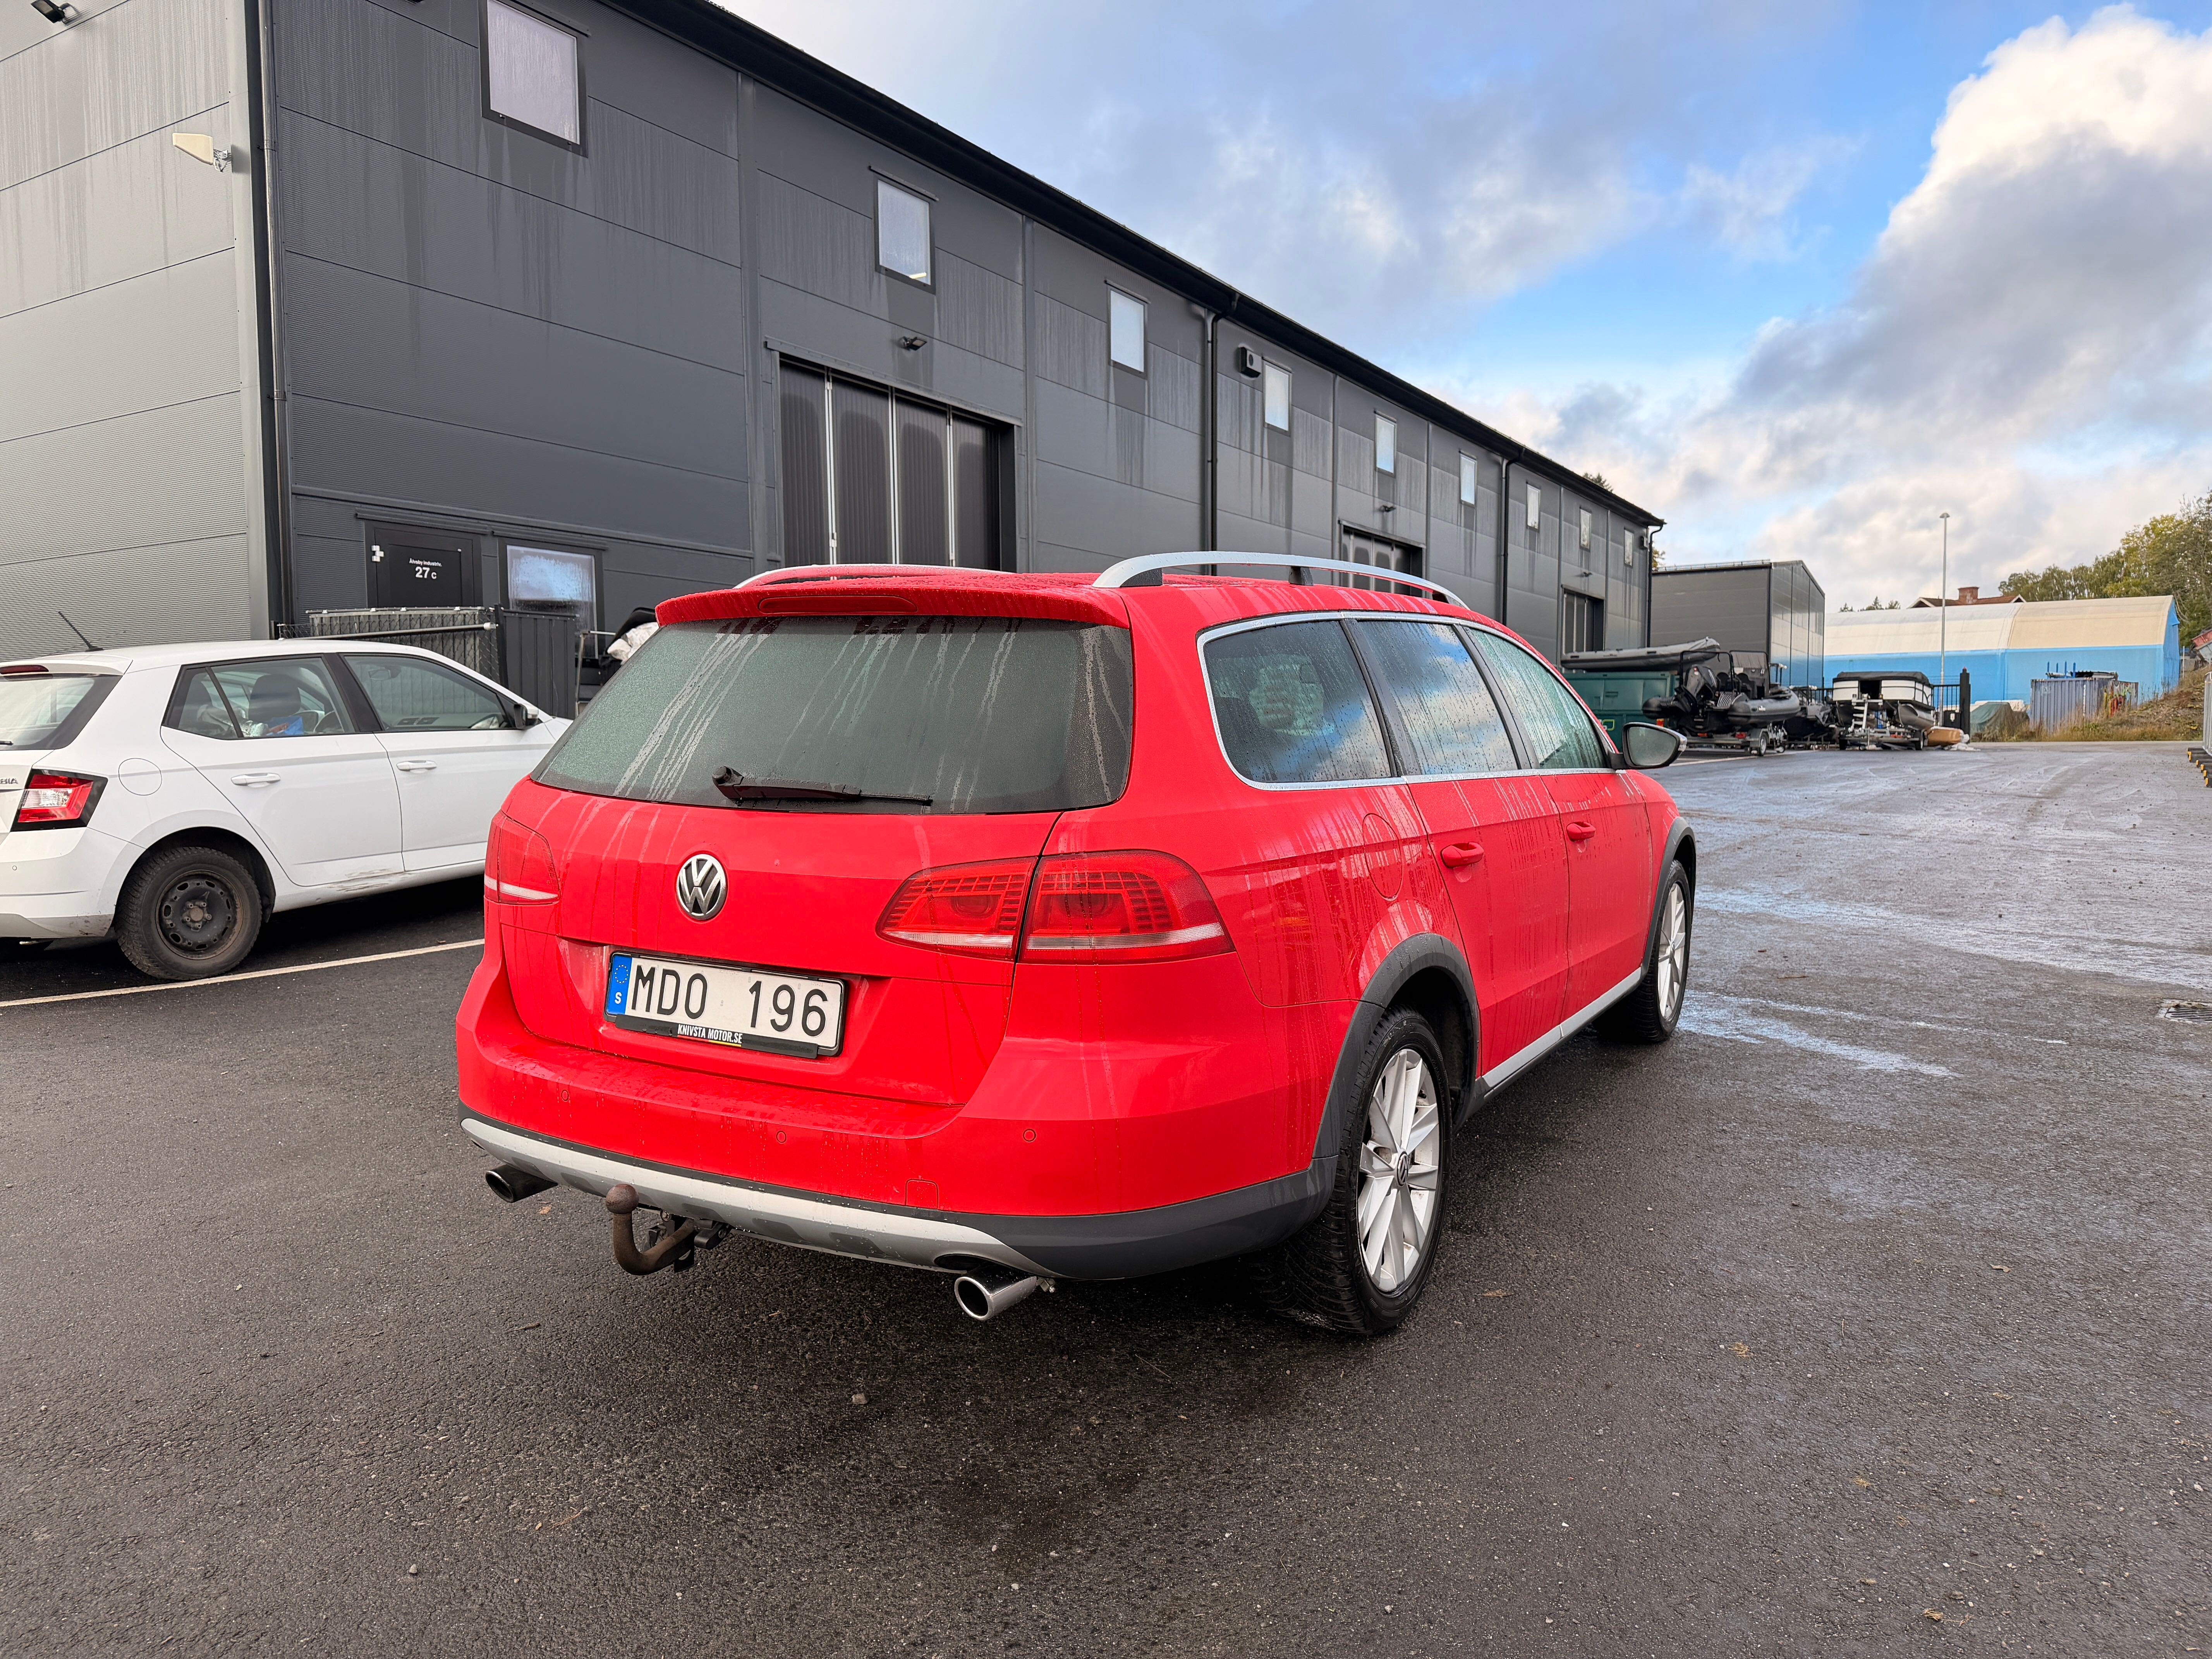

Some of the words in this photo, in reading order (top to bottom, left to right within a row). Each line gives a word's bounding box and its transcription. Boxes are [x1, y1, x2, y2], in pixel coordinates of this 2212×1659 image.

[415, 566, 430, 579] 27
[614, 992, 622, 1004] S
[631, 965, 708, 1019] MDO
[749, 981, 828, 1037] 196
[677, 1024, 706, 1039] KNIVSTA
[707, 1028, 743, 1044] MOTOR.SE
